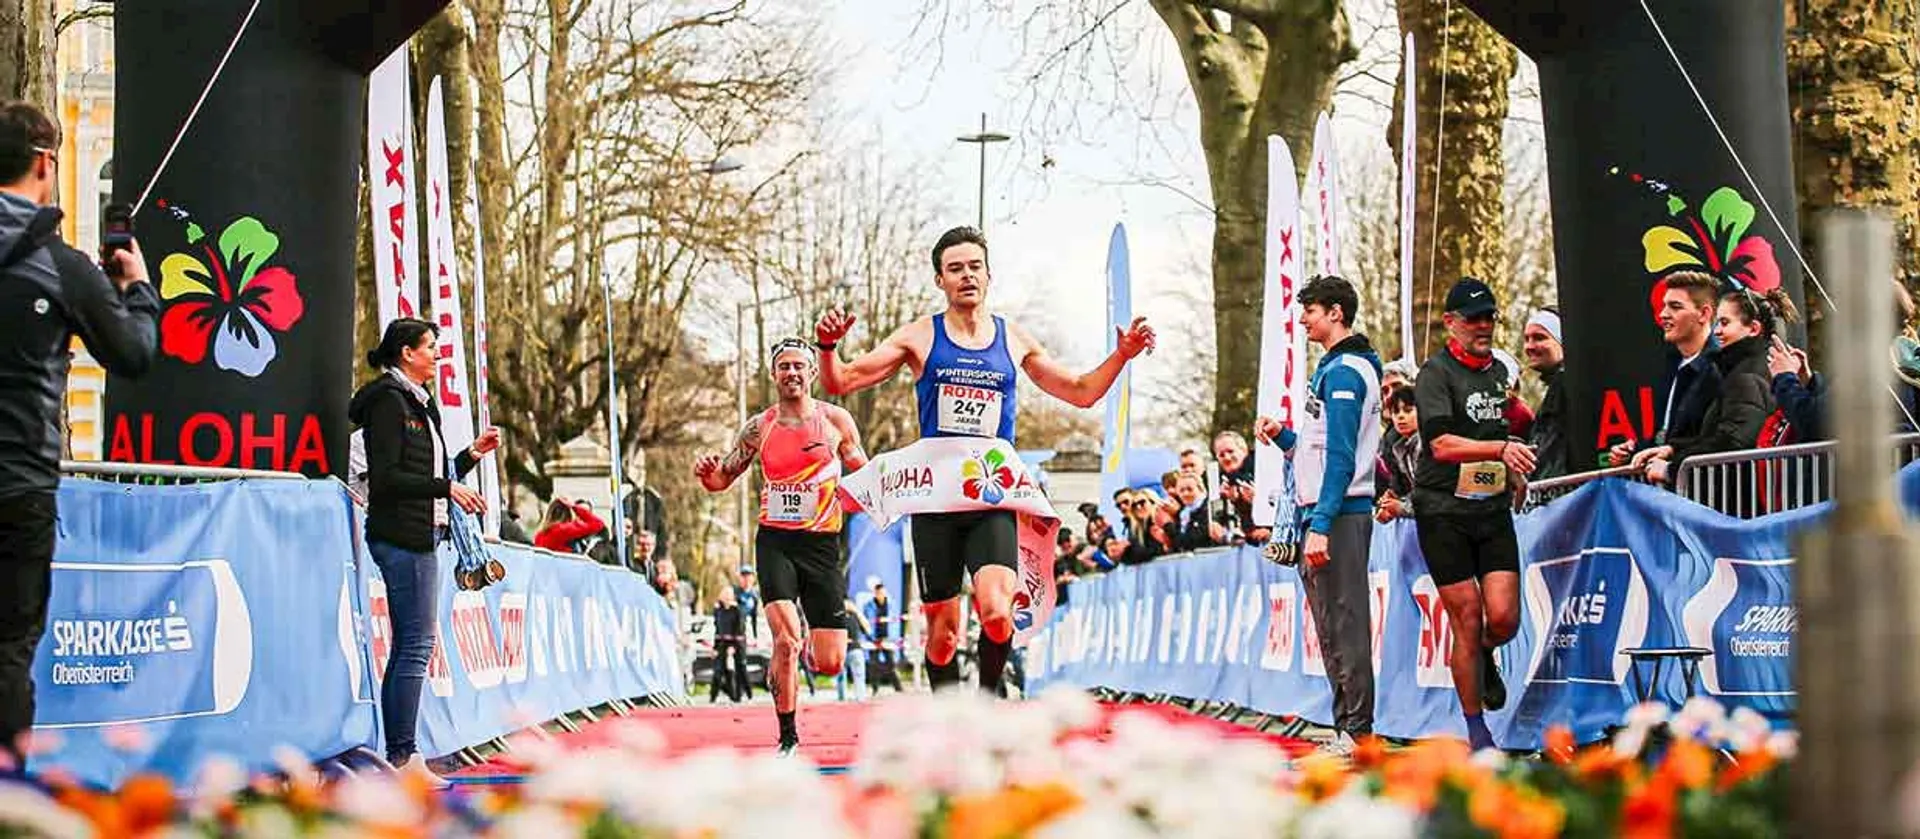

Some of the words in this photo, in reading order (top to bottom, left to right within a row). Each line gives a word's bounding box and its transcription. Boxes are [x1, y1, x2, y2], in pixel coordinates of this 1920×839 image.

[943, 385, 996, 403] ROTAX
[953, 401, 986, 417] 247
[109, 411, 329, 475] ALOHA
[770, 482, 813, 493] ROTAX
[781, 494, 801, 506] 119
[1735, 604, 1797, 633] SPARK
[53, 619, 165, 656] SPARKASSE
[52, 660, 134, 685] Oberösterreich
